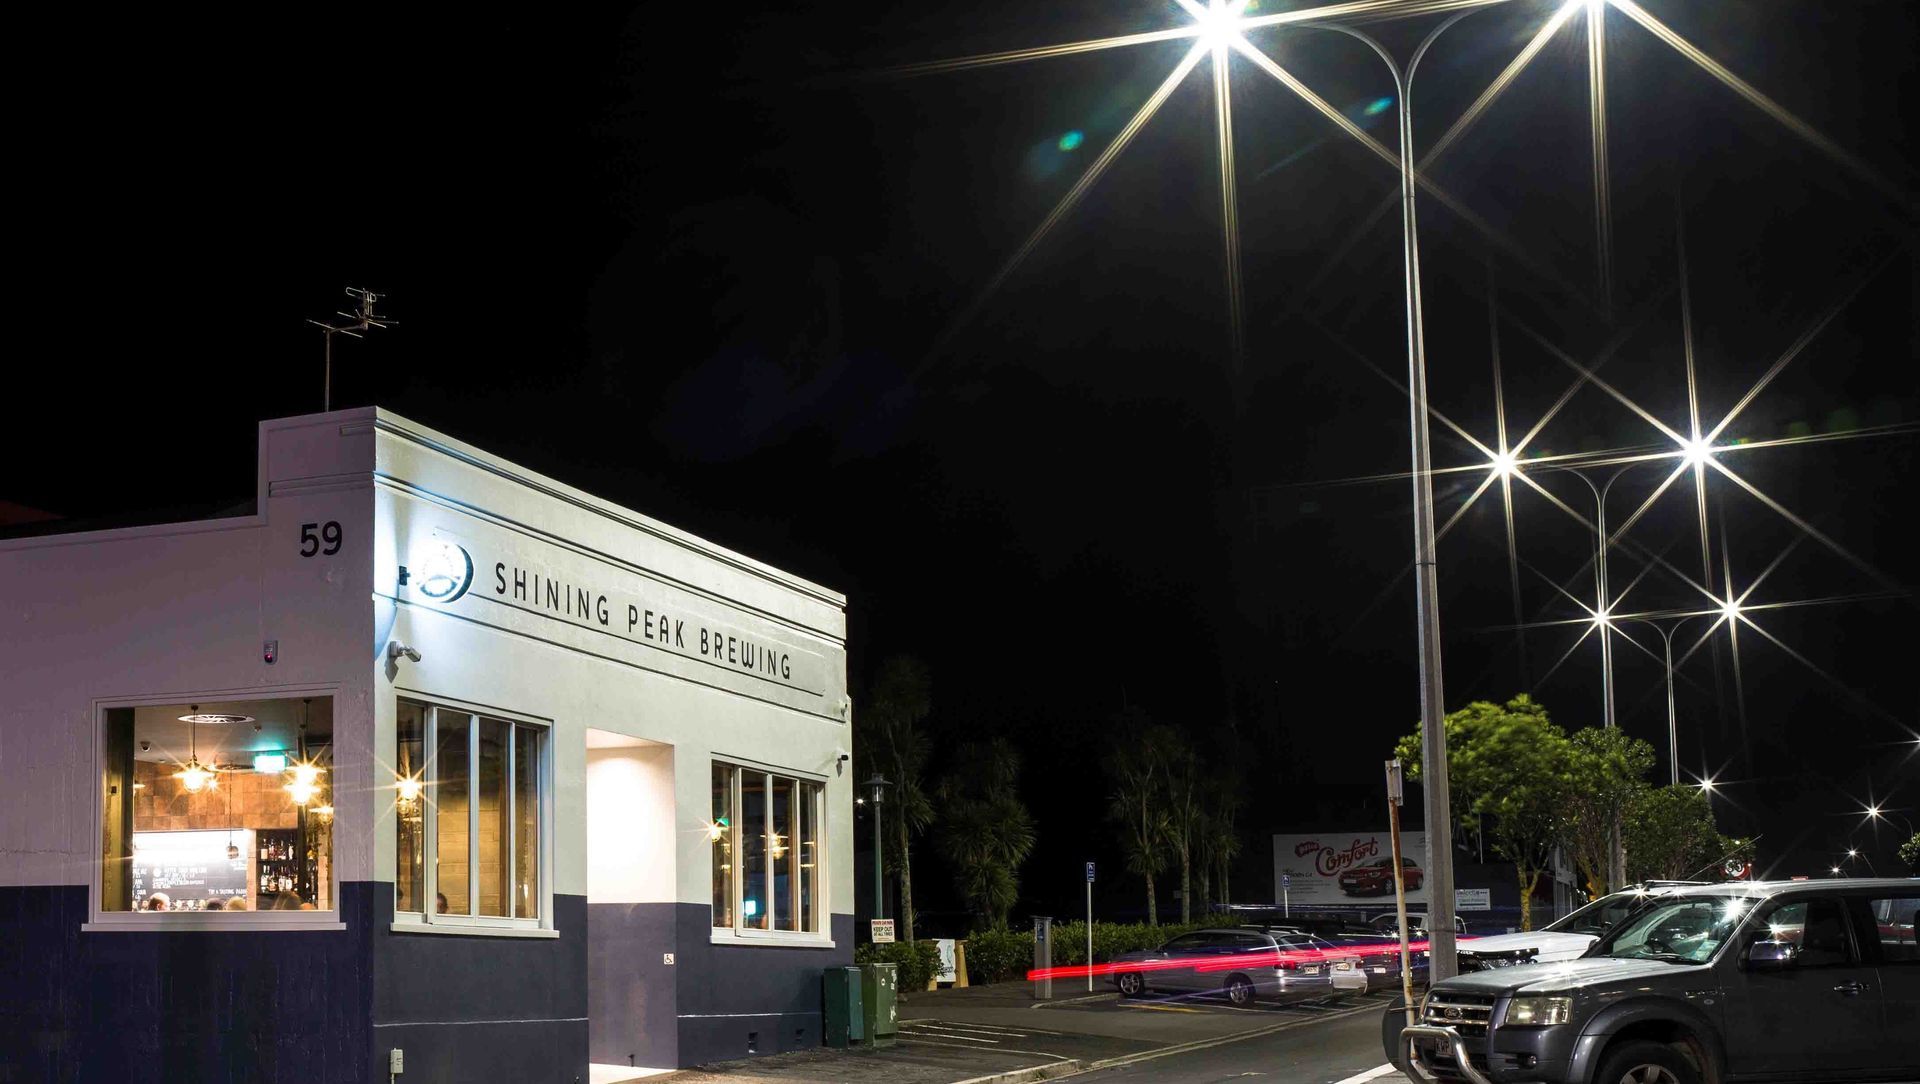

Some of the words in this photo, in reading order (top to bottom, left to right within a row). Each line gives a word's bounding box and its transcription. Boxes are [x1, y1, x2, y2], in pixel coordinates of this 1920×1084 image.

[300, 520, 343, 558] 59
[495, 562, 609, 626] SHINING
[628, 604, 685, 649] PEAK
[701, 627, 791, 680] BREWING
[1315, 837, 1378, 876] Comfort
[1436, 1039, 1453, 1053] KWP
